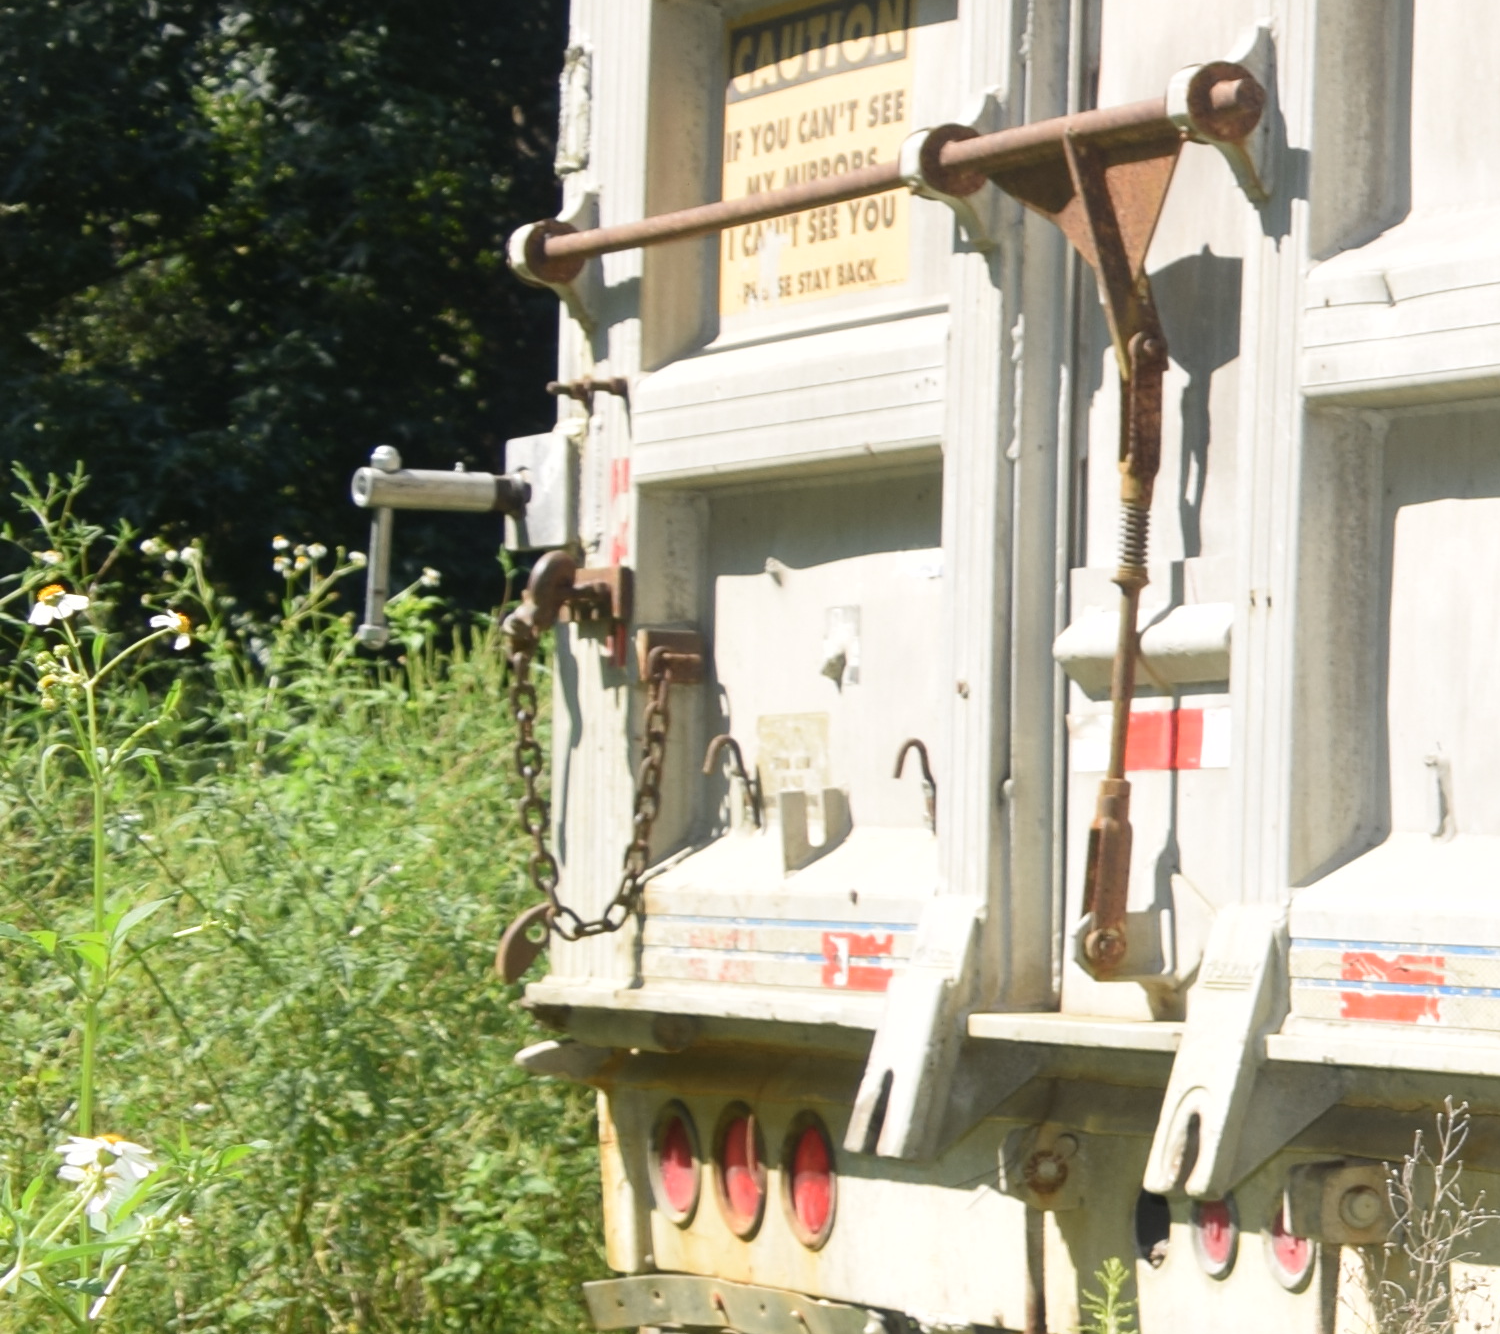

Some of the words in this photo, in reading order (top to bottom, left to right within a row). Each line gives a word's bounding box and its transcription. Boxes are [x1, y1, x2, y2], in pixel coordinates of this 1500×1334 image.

[726, 131, 742, 163] IF
[750, 117, 790, 156] YOU
[797, 99, 859, 143] CAN'T
[868, 89, 906, 128] SEE
[746, 173, 776, 197] MY
[807, 205, 838, 244] SEE
[848, 195, 896, 234] YOU
[797, 266, 831, 294] STAY
[836, 257, 877, 286] BACK
